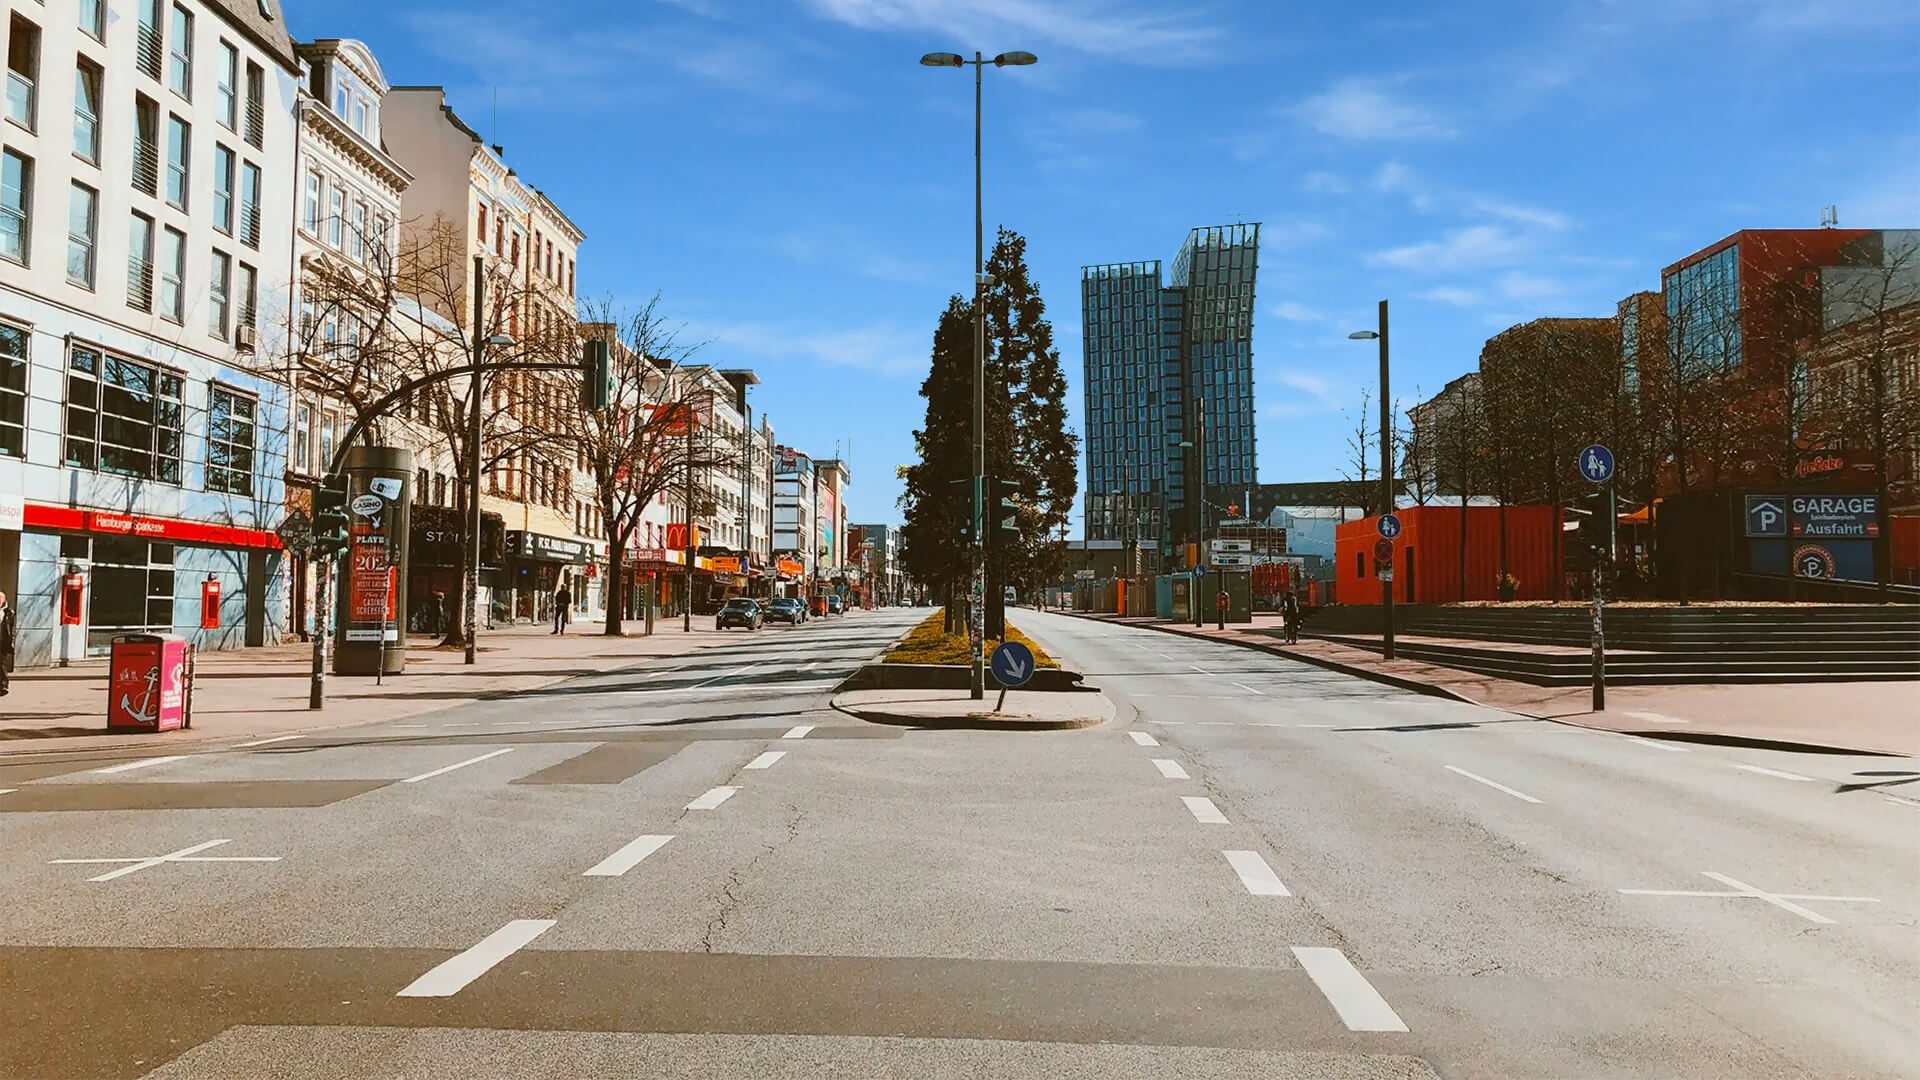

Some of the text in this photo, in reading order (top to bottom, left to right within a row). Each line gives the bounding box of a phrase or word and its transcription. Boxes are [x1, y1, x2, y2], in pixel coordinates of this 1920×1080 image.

[353, 501, 381, 509] CASINO
[1793, 498, 1876, 513] GARAGE
[0, 506, 20, 518] aspa
[96, 514, 165, 535] Hamburger Sparkasse
[1805, 523, 1864, 535] Ausfahrt
[356, 536, 385, 544] PLAYB
[355, 555, 385, 571] 202
